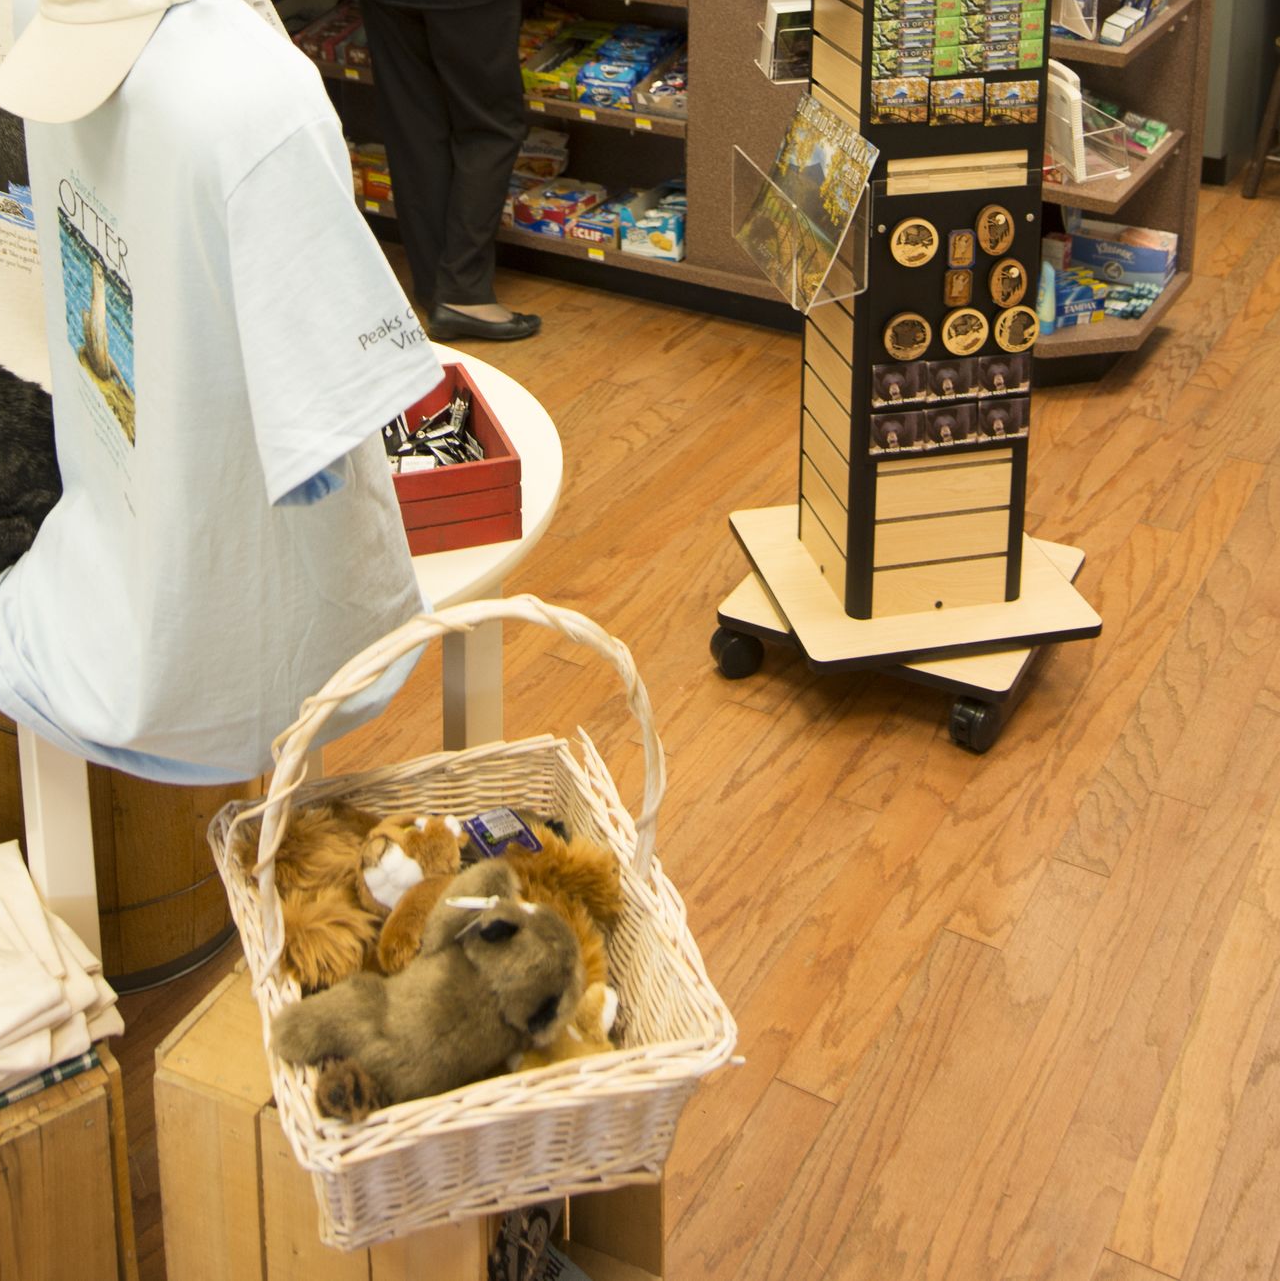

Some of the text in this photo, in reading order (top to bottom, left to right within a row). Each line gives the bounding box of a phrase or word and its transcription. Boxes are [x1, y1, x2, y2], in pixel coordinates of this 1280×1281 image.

[58, 178, 131, 283] OTTER
[574, 227, 602, 242] CLIF
[1063, 301, 1096, 315] TAMPAX
[358, 315, 403, 351] Peaks
[390, 323, 427, 350] Virg
